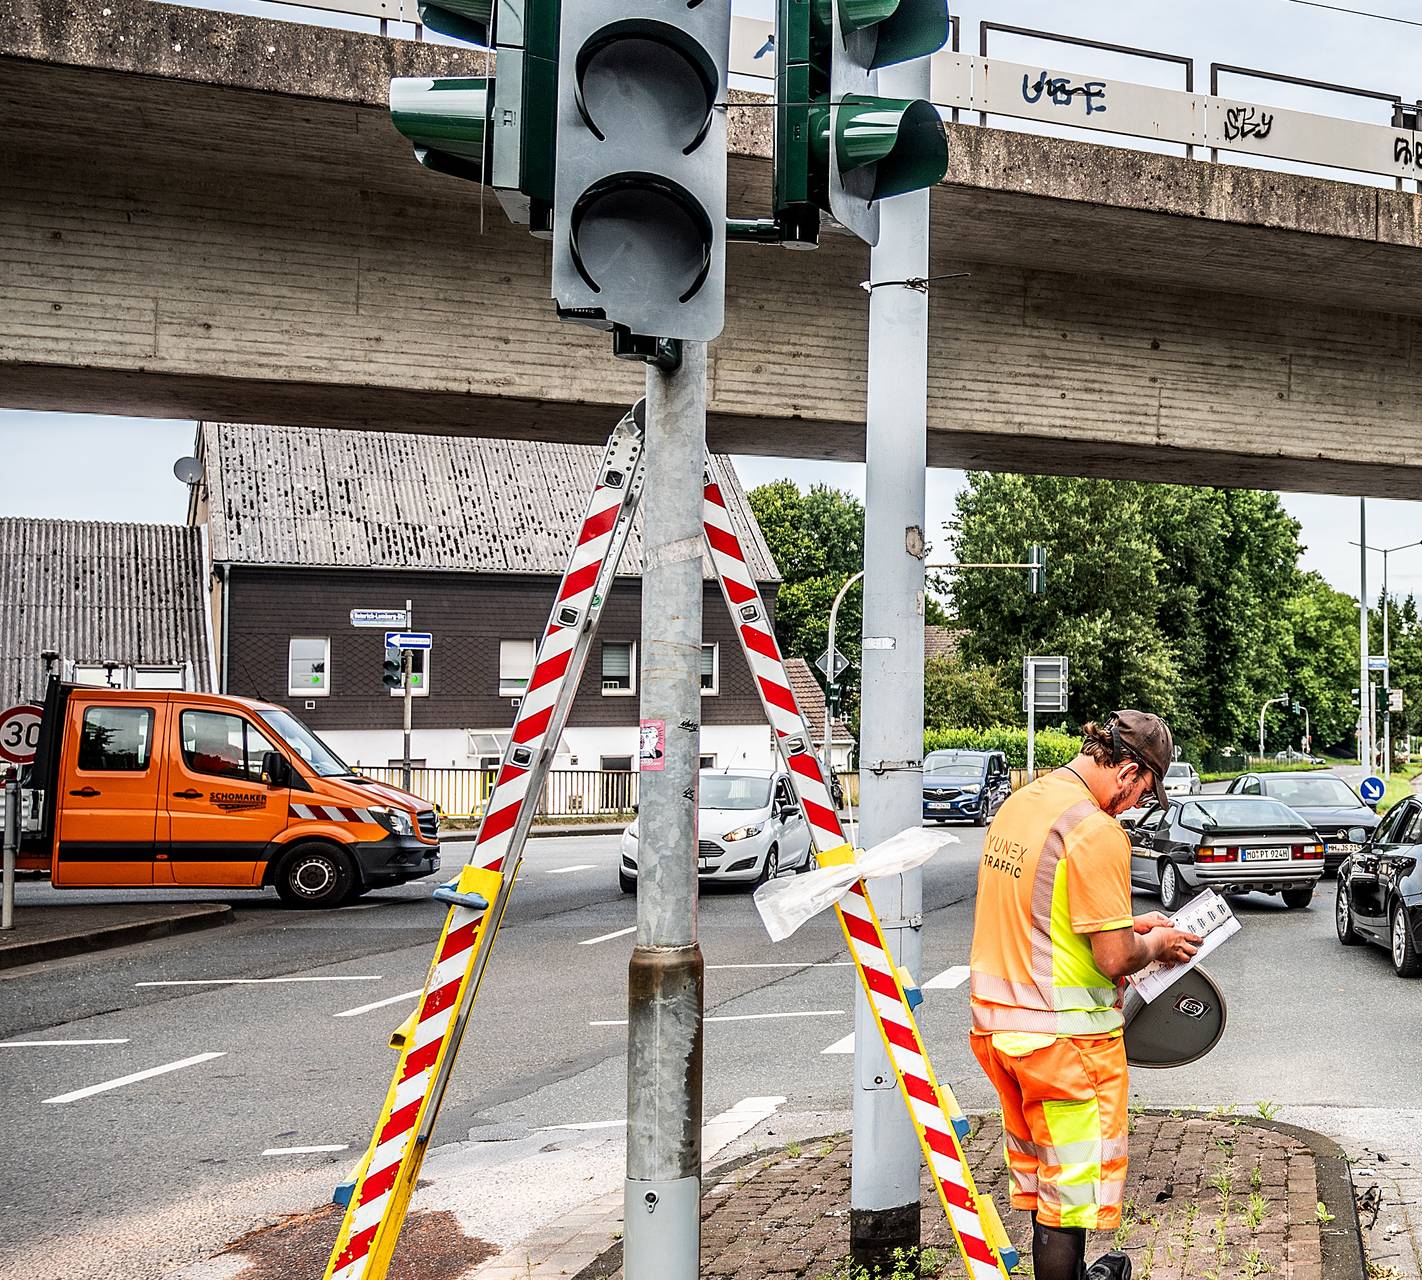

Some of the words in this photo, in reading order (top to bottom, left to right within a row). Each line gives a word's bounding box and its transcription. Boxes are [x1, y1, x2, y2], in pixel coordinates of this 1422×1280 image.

[4, 721, 42, 748] 30
[209, 791, 268, 802] SCHOMAKER
[988, 834, 1028, 863] YUNEX
[1260, 850, 1270, 858] PT
[1270, 848, 1288, 858] 924H
[984, 854, 1022, 879] TRAFFIC
